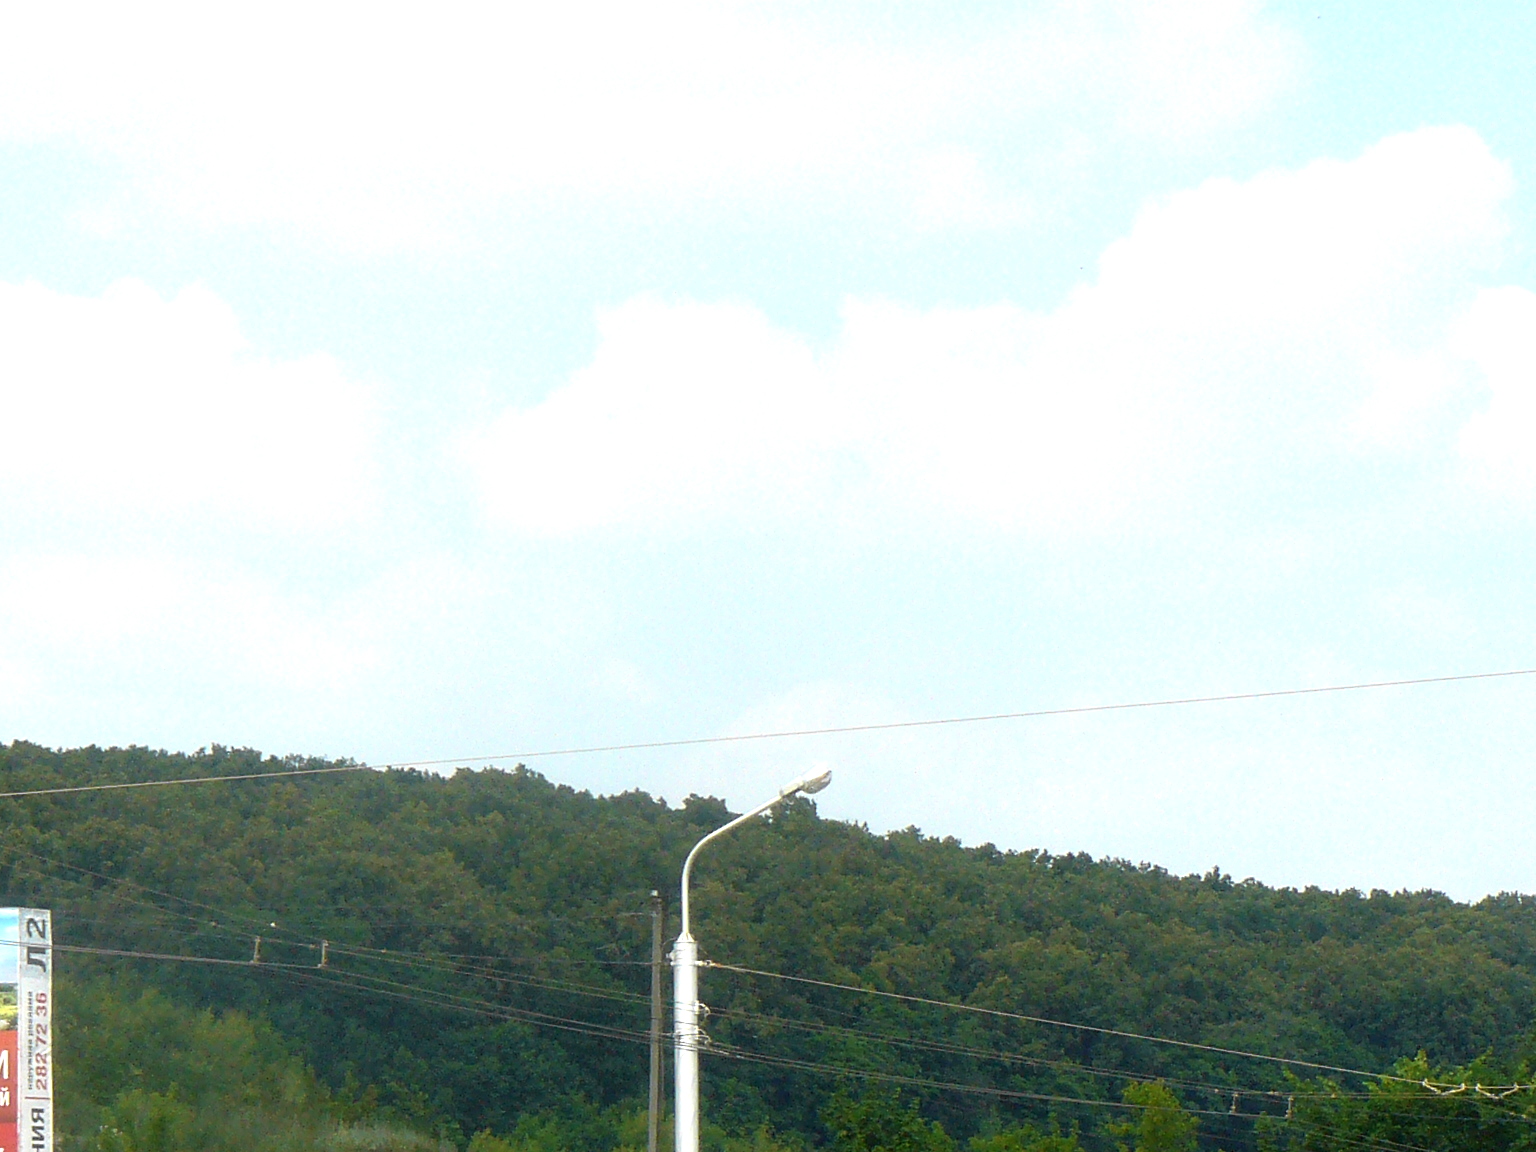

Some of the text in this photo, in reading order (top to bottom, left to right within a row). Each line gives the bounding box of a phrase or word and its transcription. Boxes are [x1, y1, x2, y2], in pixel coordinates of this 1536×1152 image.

[35, 992, 48, 1091] 282 72 36
